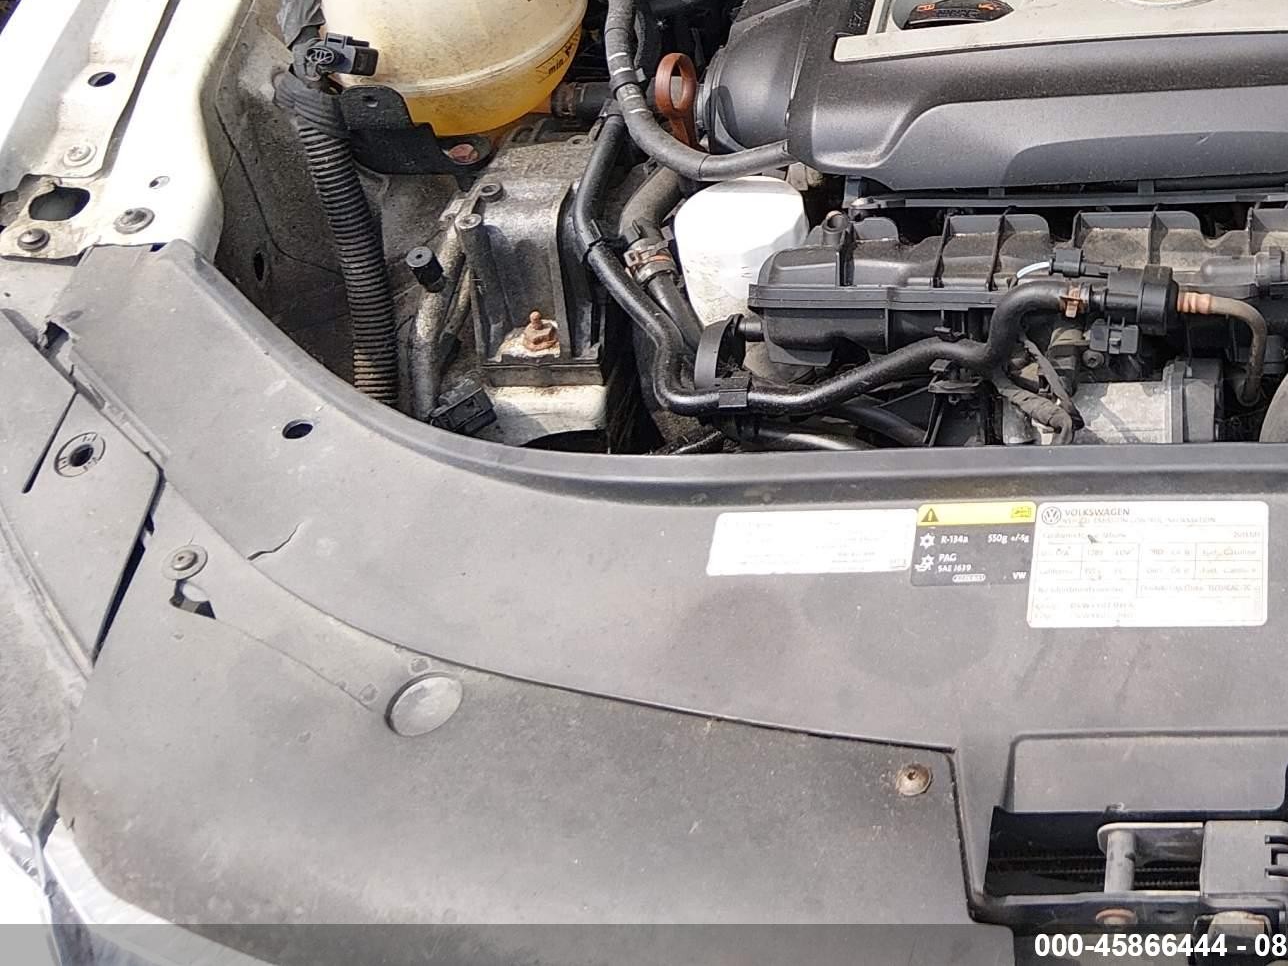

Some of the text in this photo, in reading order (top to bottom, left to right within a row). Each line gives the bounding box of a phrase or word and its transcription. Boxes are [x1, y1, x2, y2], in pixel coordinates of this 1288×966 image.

[1065, 508, 1130, 517] VOLKSWAGEN
[941, 535, 969, 544] R-134a
[939, 553, 957, 562] PAG
[938, 564, 952, 572] SAE
